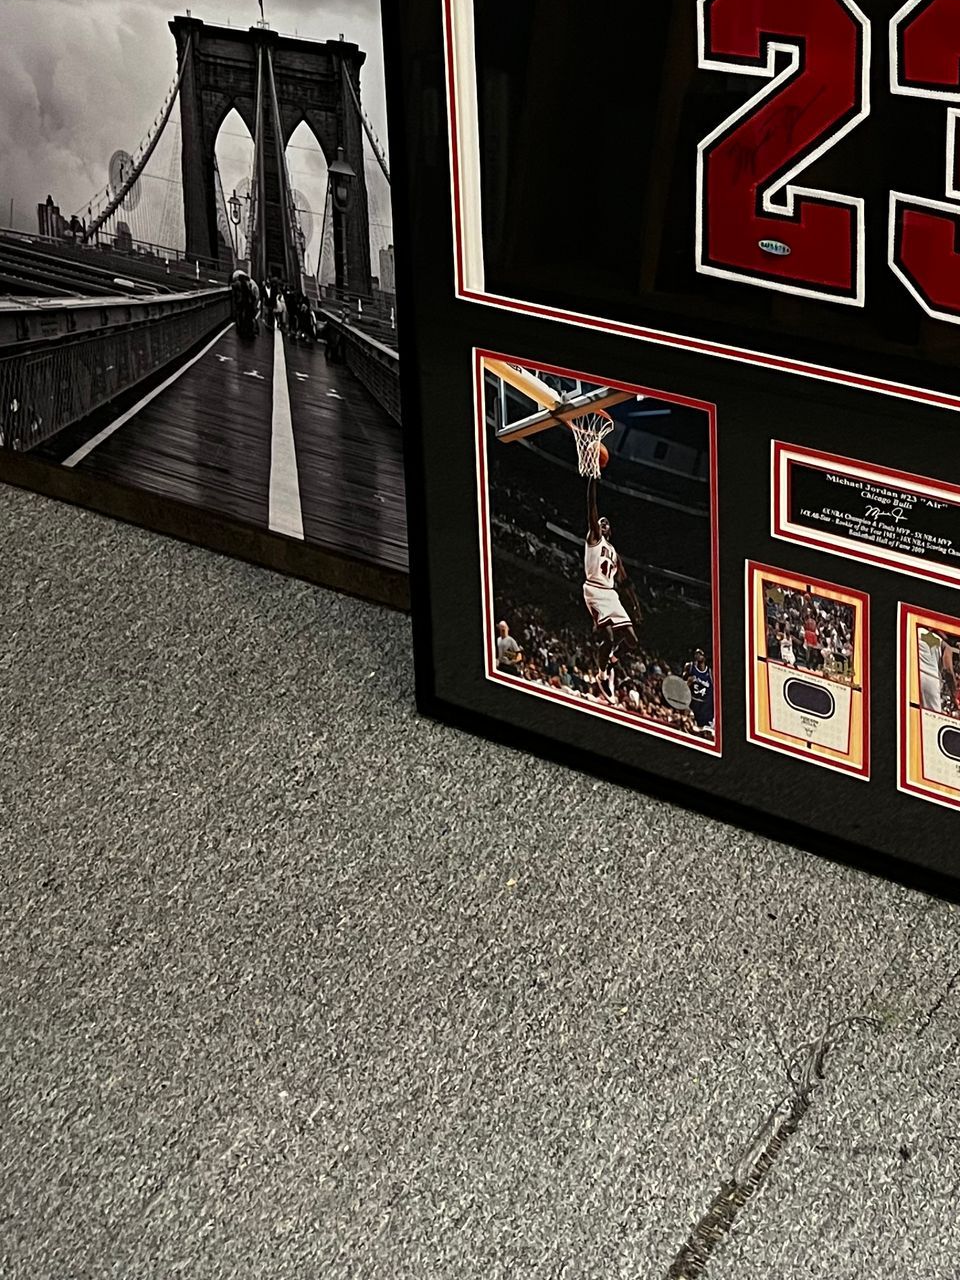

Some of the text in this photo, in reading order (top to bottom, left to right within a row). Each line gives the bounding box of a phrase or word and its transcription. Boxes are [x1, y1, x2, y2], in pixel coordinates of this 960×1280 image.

[826, 473, 863, 489] Michael
[864, 483, 898, 498] Jordan
[900, 493, 918, 503] #23
[860, 490, 913, 510] Chicago Bulls
[830, 509, 844, 518] NBA
[923, 533, 937, 543] NBA
[911, 538, 925, 547] NBA
